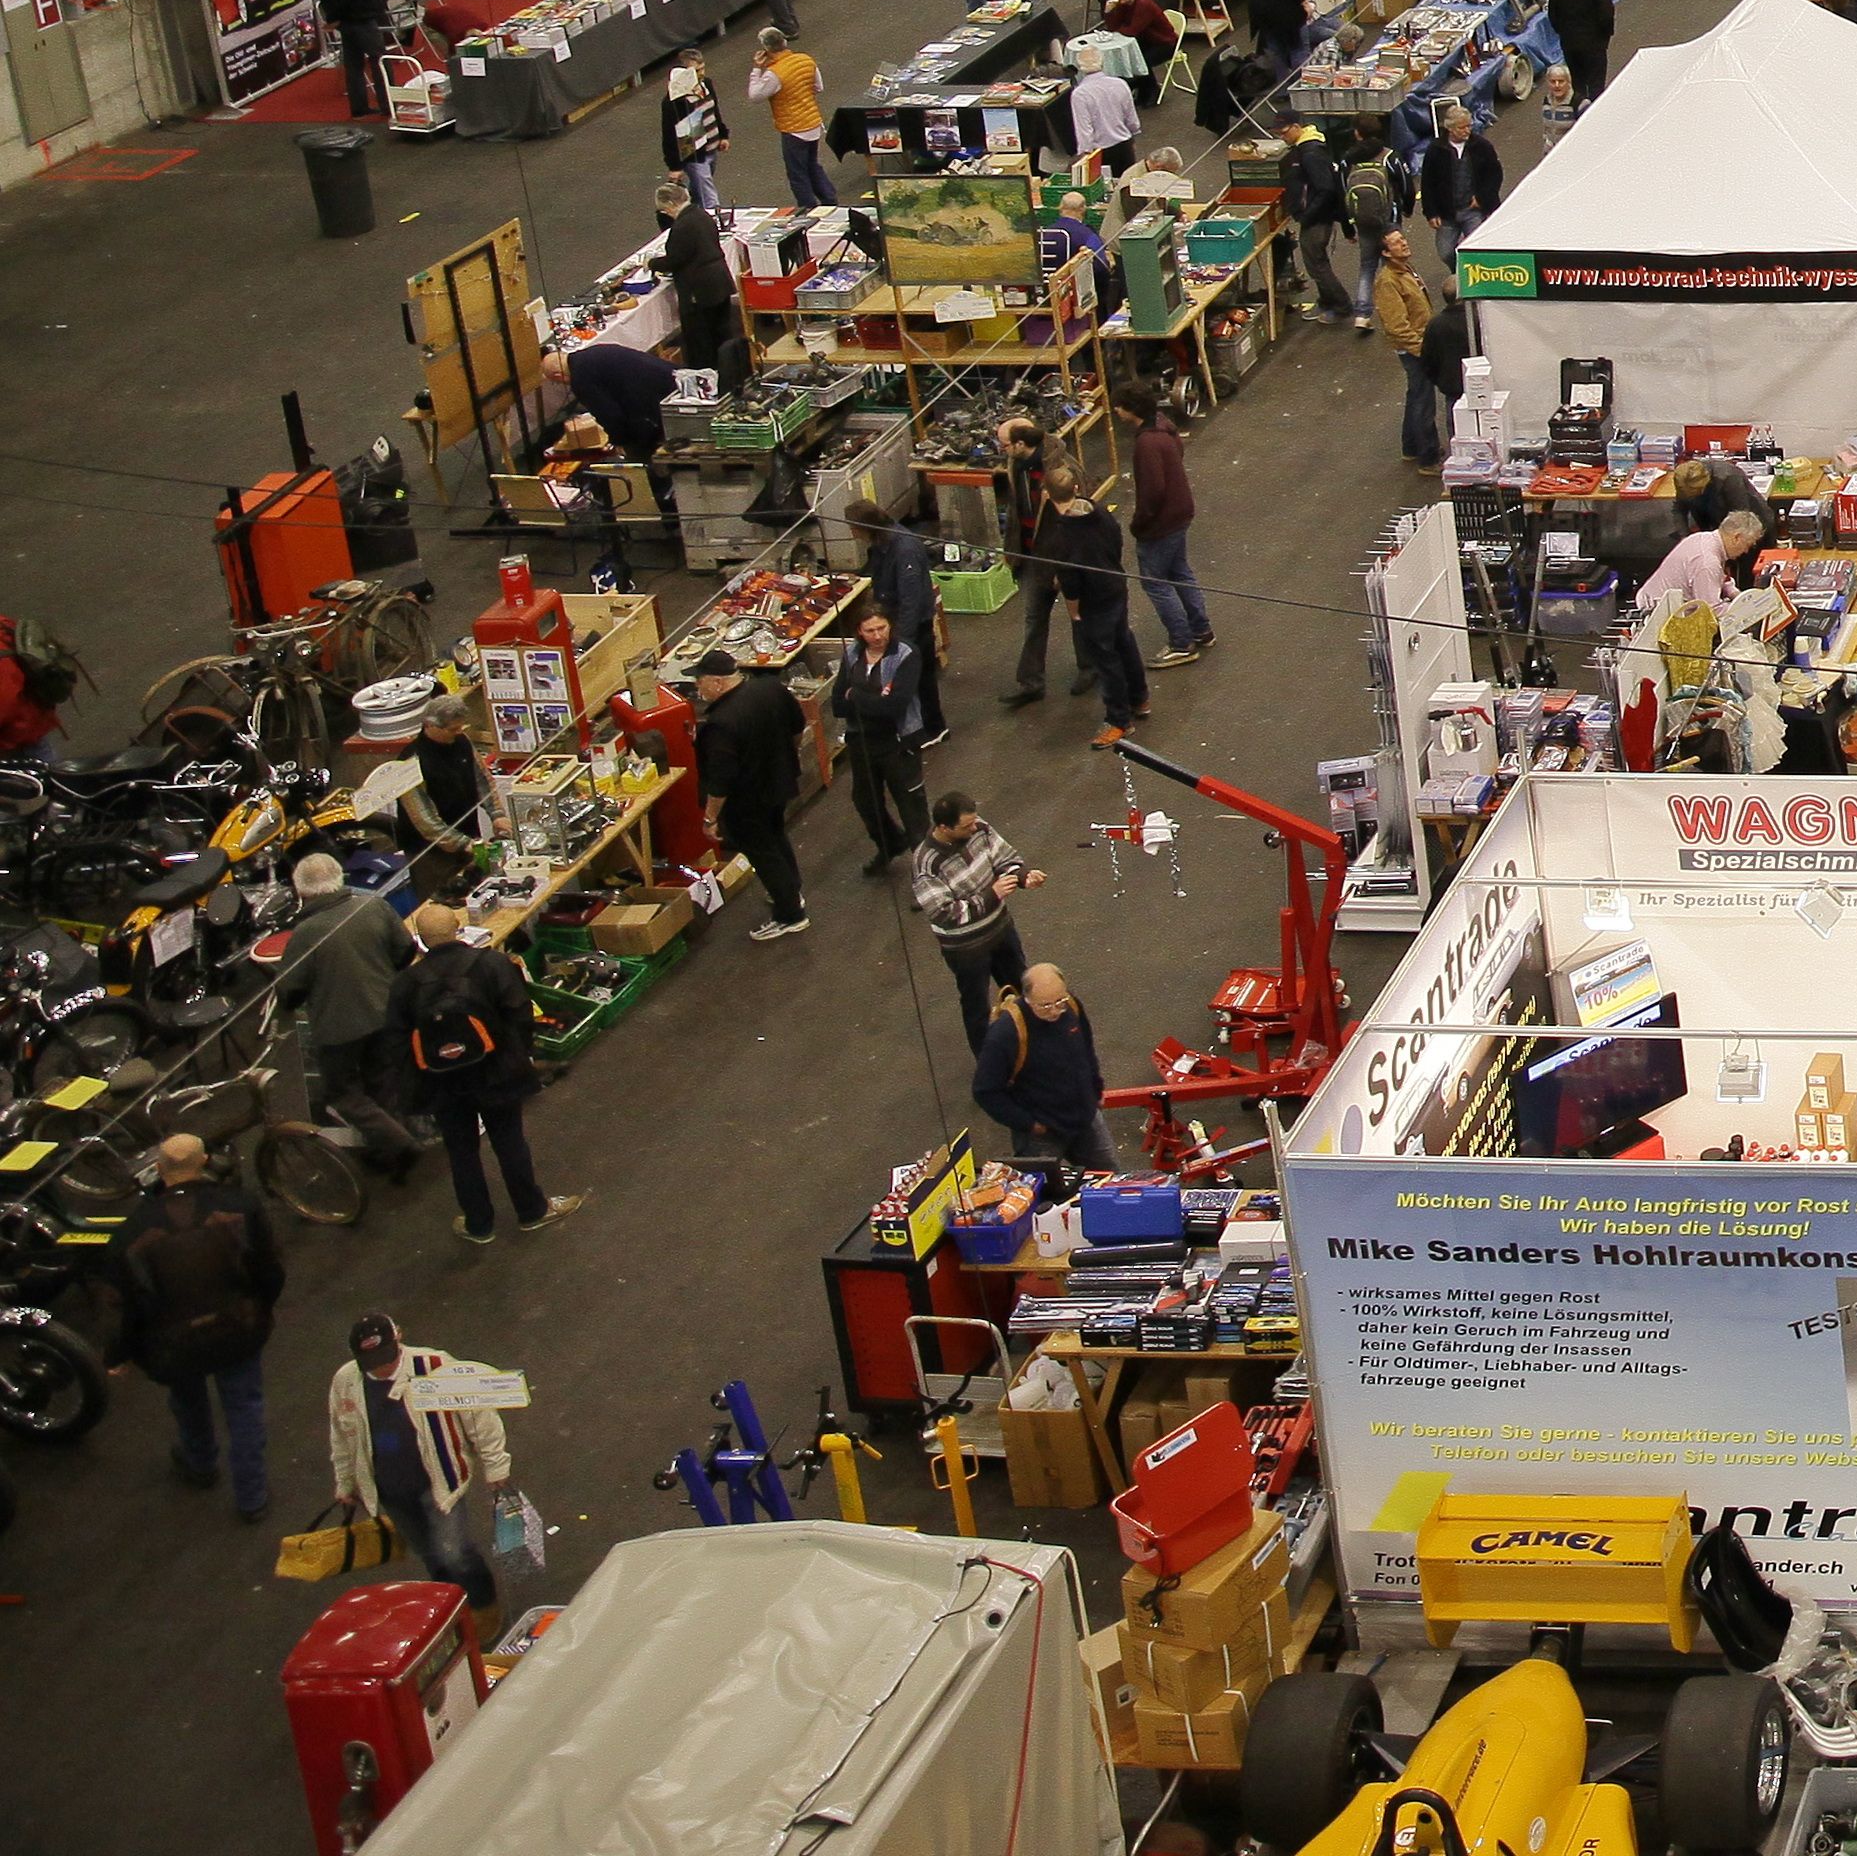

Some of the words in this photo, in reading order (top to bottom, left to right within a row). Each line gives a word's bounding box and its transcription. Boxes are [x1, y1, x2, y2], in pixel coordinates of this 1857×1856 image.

[1466, 263, 1530, 287] Norton
[1640, 892, 1665, 907] Ihr
[1673, 892, 1765, 908] Spezialist
[1771, 892, 1796, 908] für
[1593, 945, 1644, 975] Scantrade
[1368, 857, 1519, 1128] Scantrade
[1584, 983, 1618, 1012] 10%
[1396, 1192, 1491, 1211] Möchten
[1498, 1194, 1532, 1211] Sie
[1539, 1195, 1568, 1212] Ihr
[1575, 1196, 1627, 1213] Auto
[1634, 1197, 1747, 1217] langfristig
[1754, 1200, 1792, 1214] vor
[1797, 1198, 1849, 1214] Rost
[1559, 1218, 1588, 1234] Wir
[1603, 1220, 1671, 1236] haben
[1678, 1220, 1711, 1237] die
[1719, 1219, 1811, 1240] Lösung!
[1327, 1238, 1415, 1262] Mike
[1427, 1240, 1580, 1265] Sanders
[1348, 1286, 1442, 1303] wirksames
[1447, 1287, 1495, 1303] Mittel
[1499, 1290, 1553, 1305] gegen
[1558, 1290, 1601, 1304] Rost
[1351, 1304, 1398, 1318] 100%
[1402, 1304, 1486, 1321] Wirkstoff,
[1491, 1306, 1538, 1321] keine
[1543, 1307, 1674, 1326] Lösungsmittel,
[1357, 1321, 1408, 1335] daher
[1412, 1322, 1448, 1336] kein
[1453, 1323, 1518, 1338] Geruch
[1523, 1324, 1543, 1338] im
[1549, 1325, 1630, 1342] Fahrzeug
[1636, 1326, 1670, 1340] und
[1360, 1338, 1406, 1352] keine
[1412, 1338, 1515, 1357] Gefährdung
[1519, 1341, 1549, 1355] der
[1553, 1342, 1631, 1356] Insassen
[1358, 1355, 1389, 1369] Für
[1393, 1356, 1479, 1372] Oldtimer-,
[1484, 1358, 1577, 1374] Liebhaber-
[1582, 1360, 1616, 1374] und
[1620, 1360, 1688, 1378] Alltags-
[1360, 1372, 1446, 1390] fahrzeuge
[1450, 1375, 1526, 1391] geeignet
[438, 1395, 478, 1408] BELMOT
[1369, 1421, 1406, 1437] Wir
[1412, 1423, 1492, 1440] beraten
[1500, 1424, 1535, 1440] Sie
[1540, 1428, 1600, 1444] gerne
[1621, 1429, 1758, 1445] kontaktieren
[1765, 1429, 1797, 1445] Sie
[1805, 1432, 1843, 1446] uns
[1430, 1444, 1509, 1461] Telefon
[1516, 1446, 1565, 1462] oder
[1571, 1448, 1675, 1464] besuchen
[1684, 1450, 1716, 1465] Sie
[1724, 1453, 1797, 1466] unsere
[1471, 1530, 1617, 1556] CAMEL
[1374, 1572, 1406, 1586] Fon
